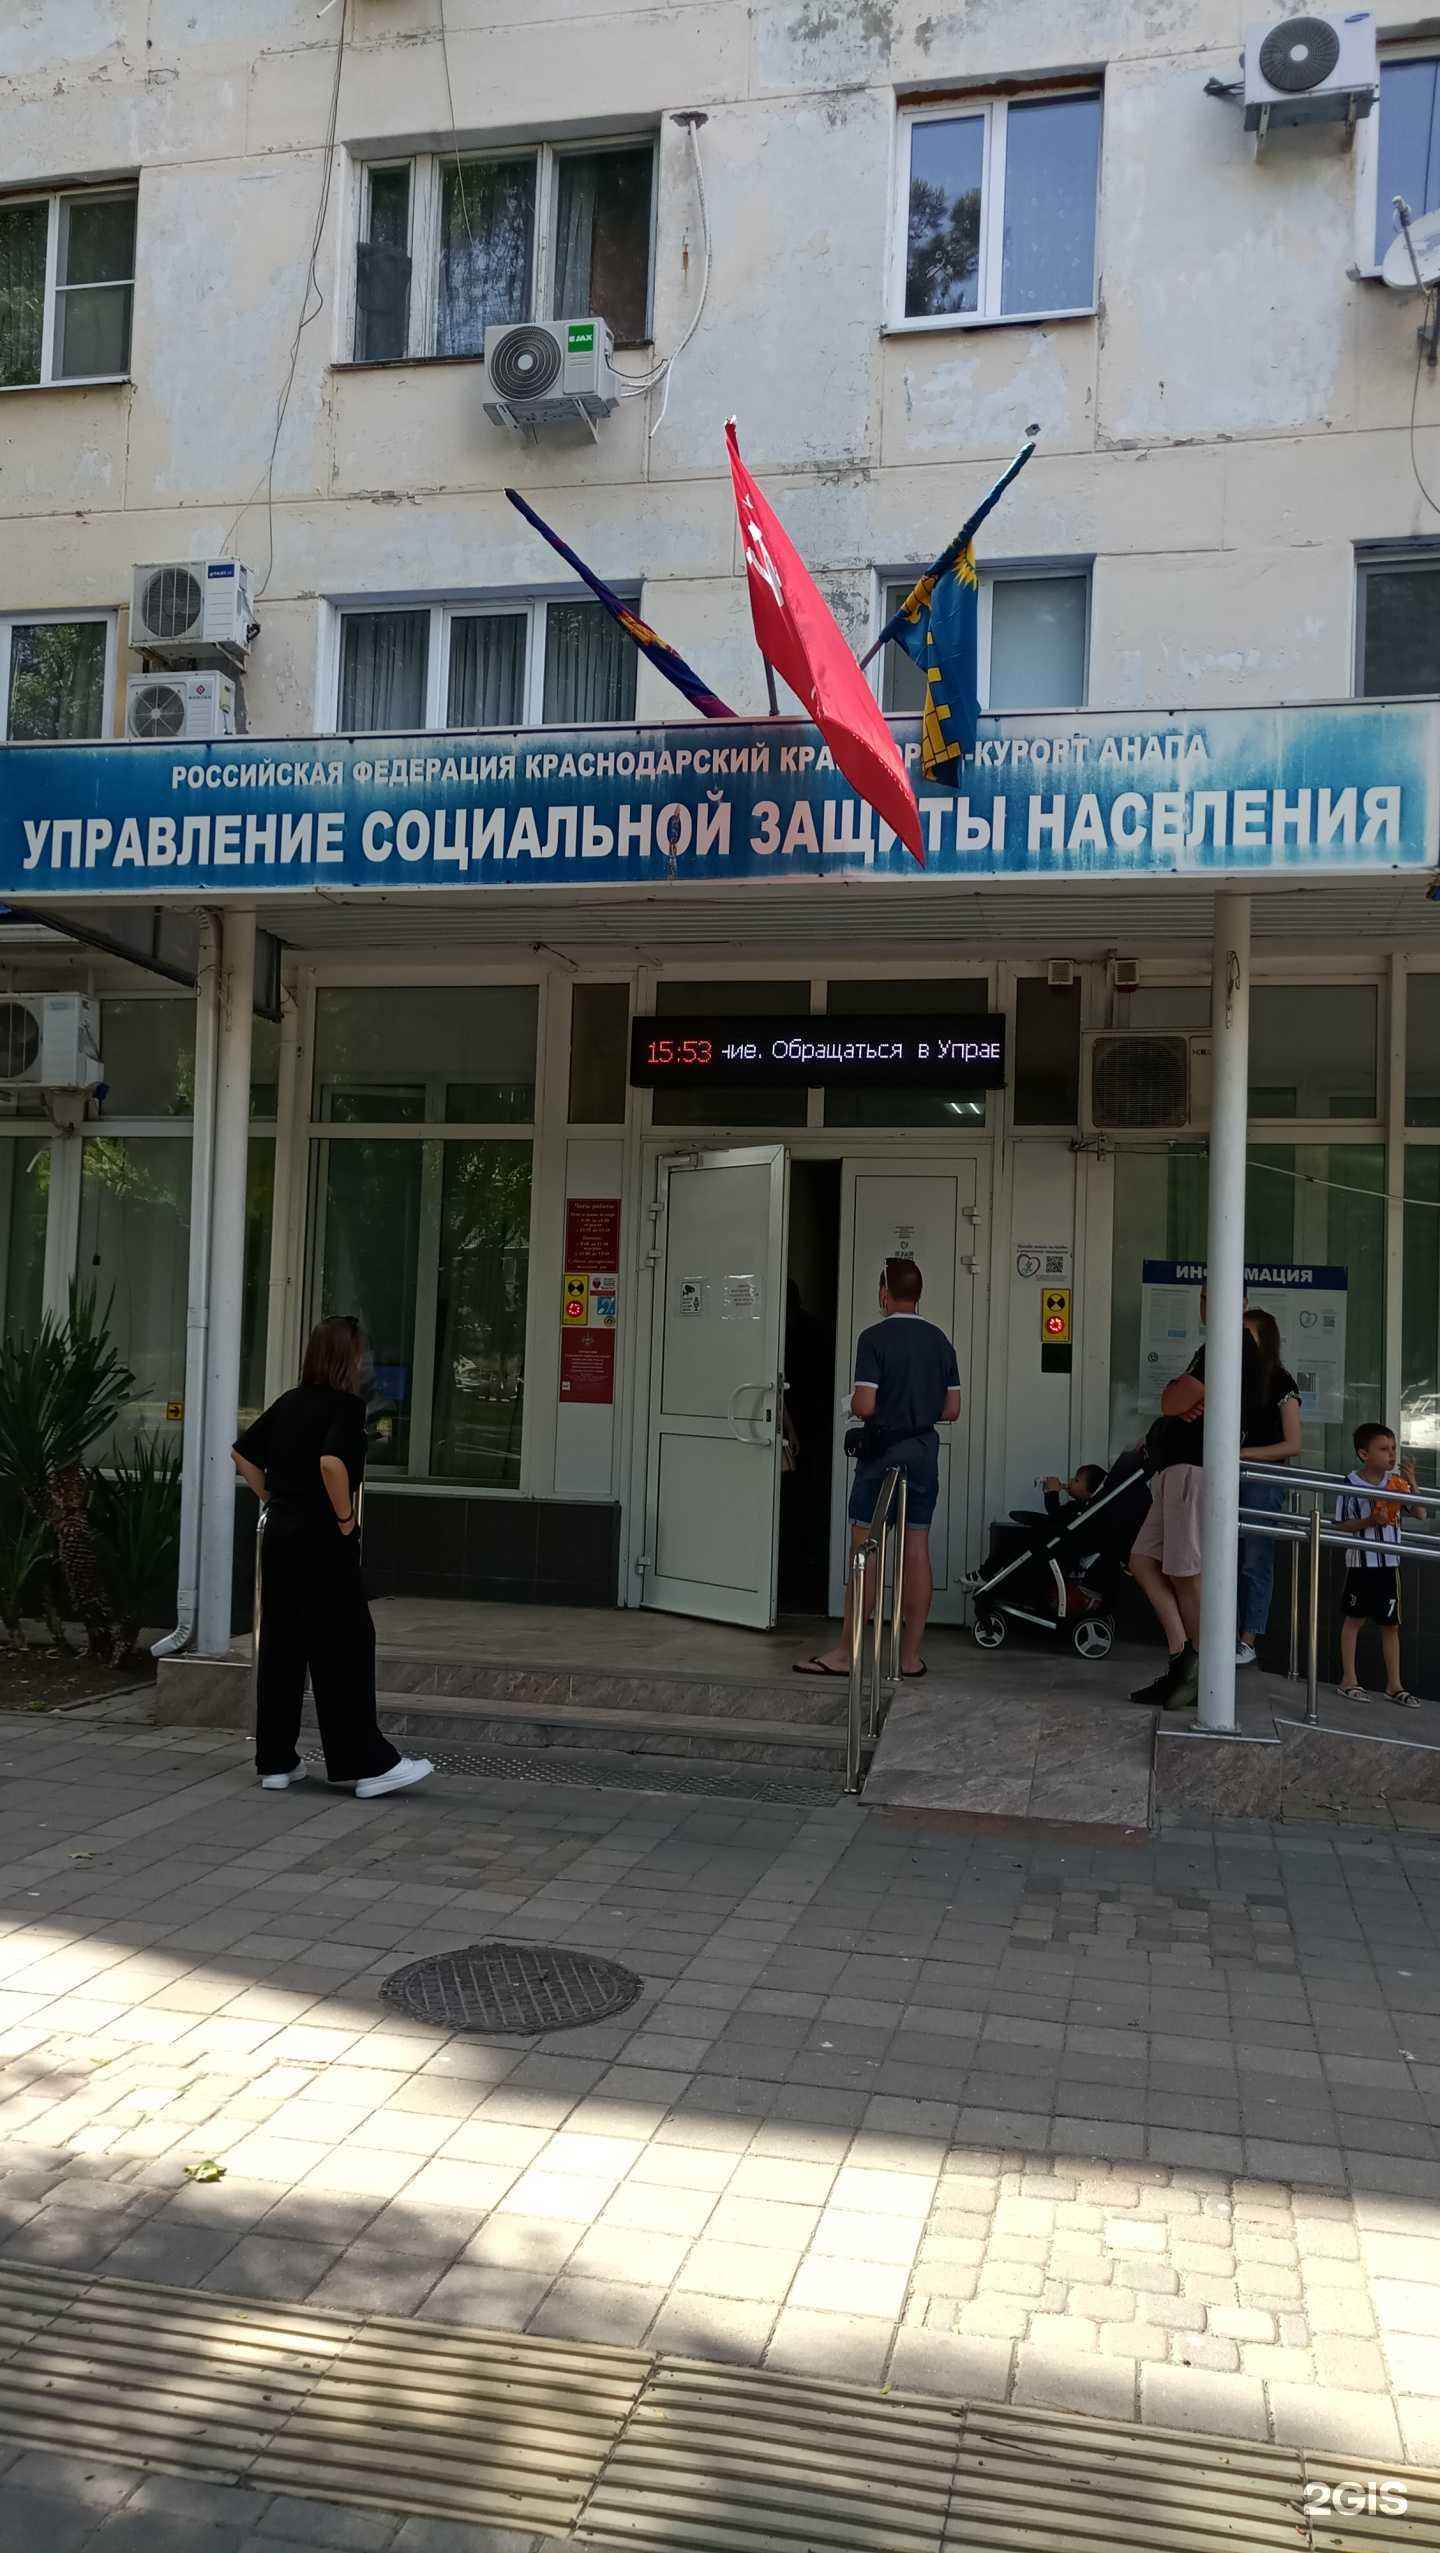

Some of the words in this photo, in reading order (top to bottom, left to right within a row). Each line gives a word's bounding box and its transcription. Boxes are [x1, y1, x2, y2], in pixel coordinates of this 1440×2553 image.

[171, 757, 344, 789] РОССИЙСКАЯ
[352, 754, 515, 787] ФЕДЕРАЦИЯ
[525, 742, 769, 780] КРАСНОДАРСКИЙ
[780, 743, 841, 772] КРА
[1099, 734, 1210, 763] АНАПА
[23, 812, 345, 869] УПРАВЛЕНИЕ
[362, 789, 731, 871] СОЦИАЛЬНОЙ
[1027, 785, 1401, 850] НАСЕЛЕНИЯ
[648, 1041, 712, 1063] 15:53
[772, 1040, 903, 1062] Обращаться
[918, 1043, 930, 1058] в
[1176, 1264, 1313, 1284] ИНМАЦИЯ
